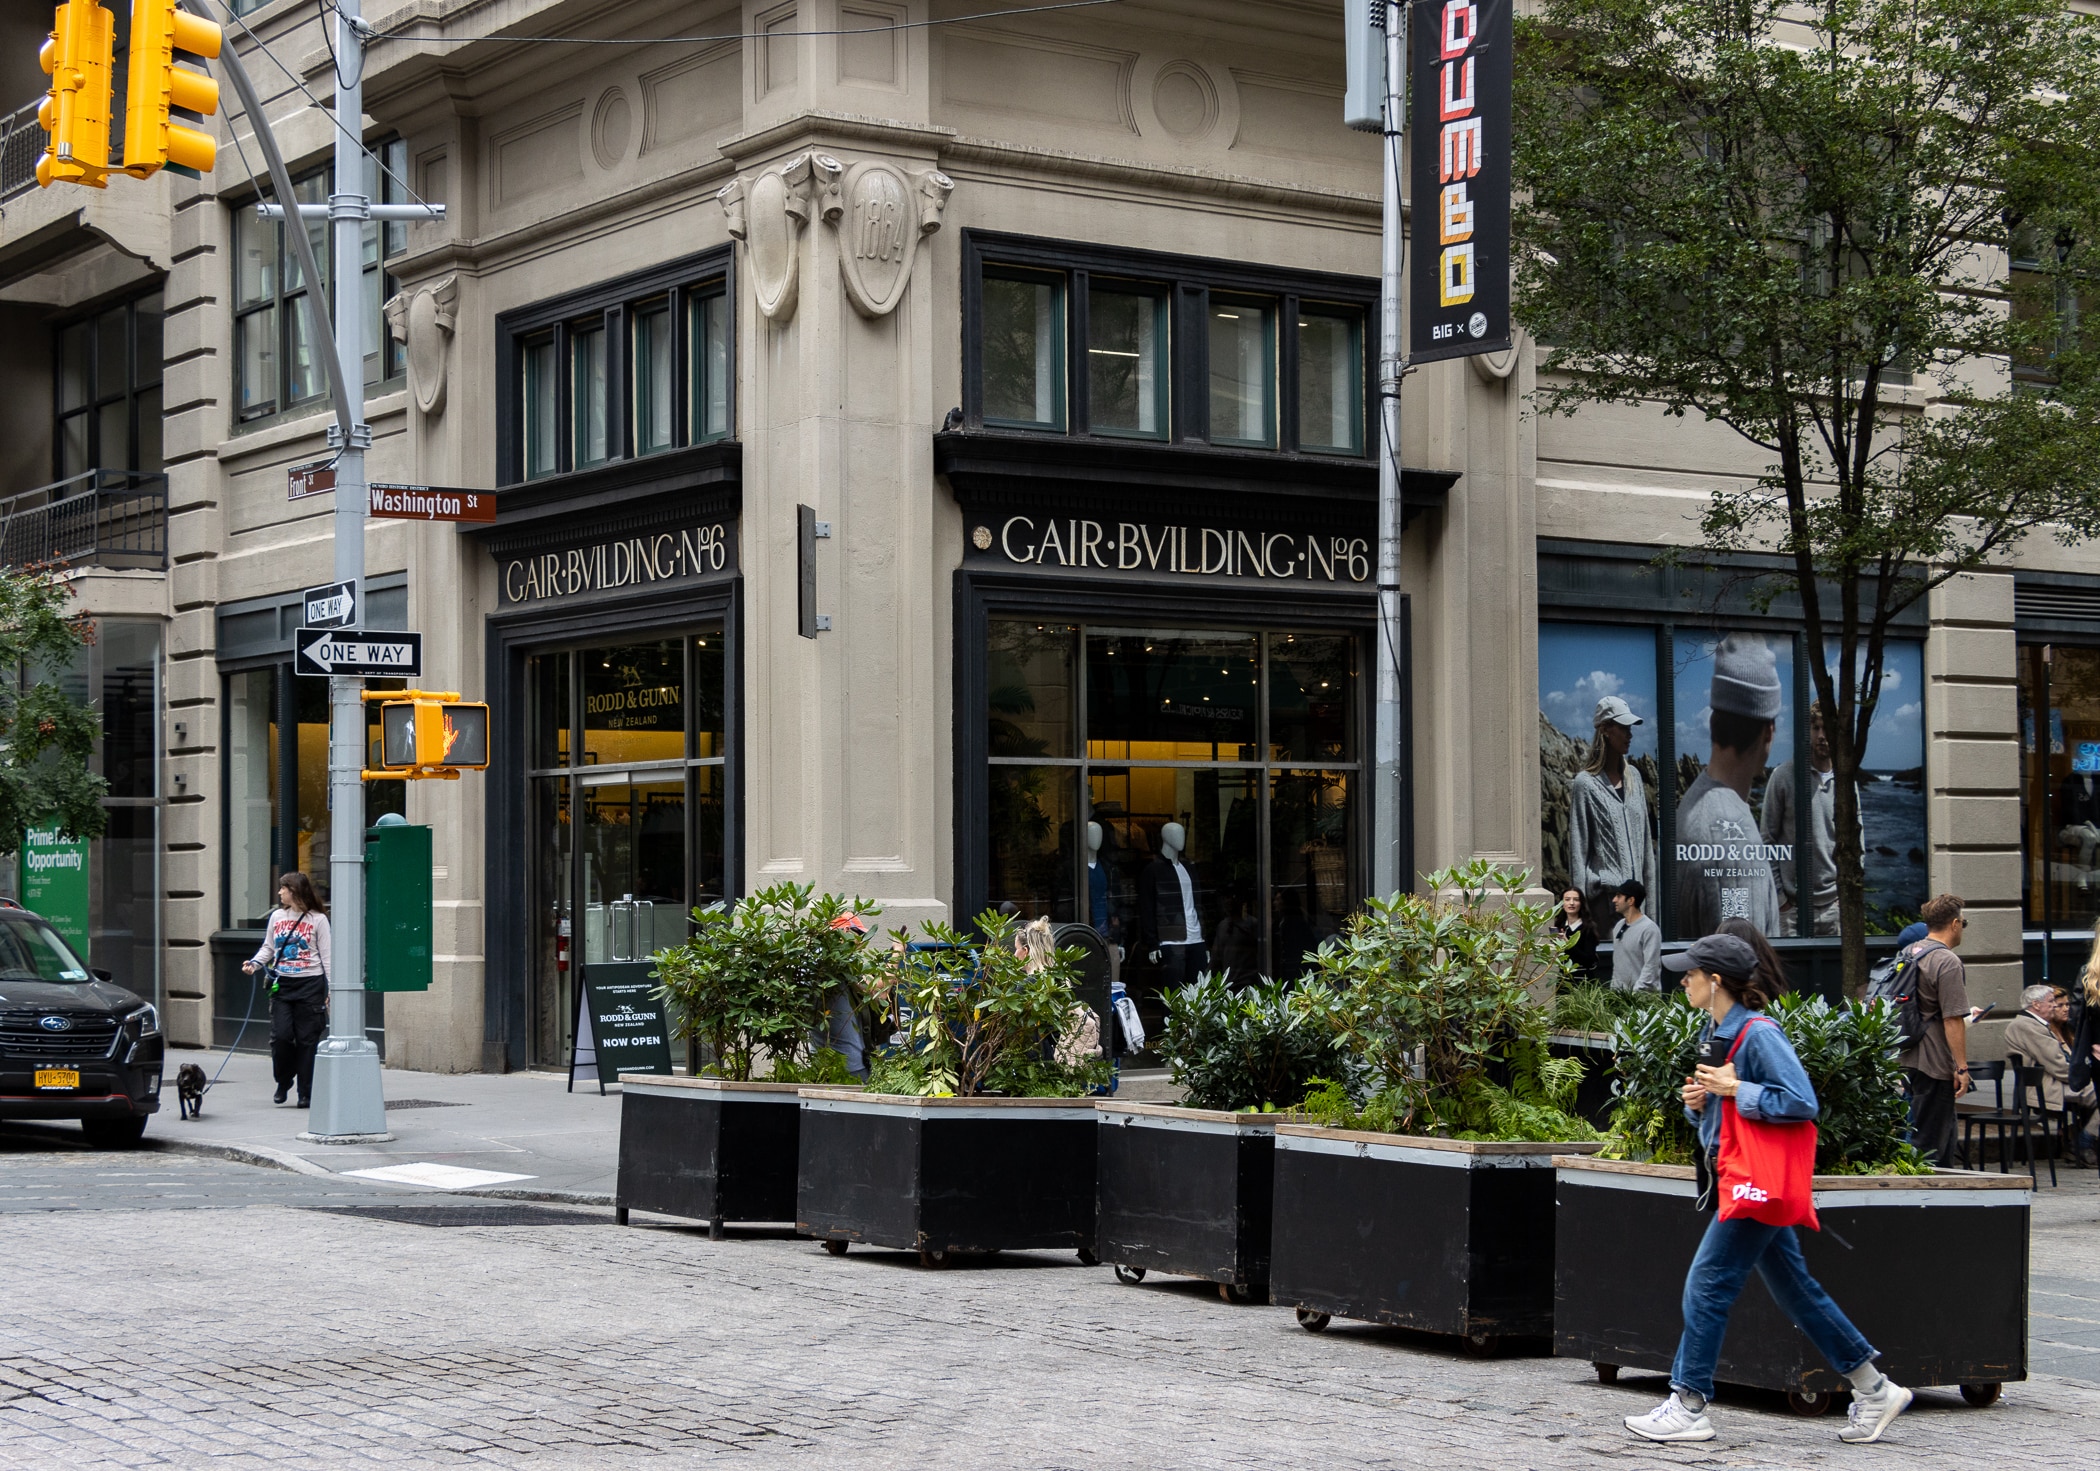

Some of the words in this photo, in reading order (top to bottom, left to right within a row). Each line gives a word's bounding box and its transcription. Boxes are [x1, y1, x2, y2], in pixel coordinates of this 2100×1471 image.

[1440, 0, 1482, 308] DUMBO
[855, 198, 905, 263] 1864
[1433, 323, 1453, 340] BIG
[289, 474, 307, 497] Front
[308, 474, 314, 486] St
[372, 490, 460, 519] Washington
[467, 495, 478, 509] St
[310, 601, 326, 620] ONE
[327, 597, 343, 617] WAY
[320, 644, 357, 661] ONE
[367, 645, 405, 663] WAY
[587, 692, 625, 714] RODD
[626, 690, 638, 709] &
[638, 686, 680, 708] GUNN
[608, 718, 624, 729] NEW
[625, 715, 658, 727] ZEALAND
[27, 828, 53, 847] Prime
[27, 849, 83, 872] Opportunity
[1676, 844, 1725, 861] RODD
[1727, 844, 1741, 861] &
[1742, 844, 1793, 861] GUNN
[1704, 868, 1724, 877] NEW
[1726, 868, 1766, 877] ZEALAND
[600, 1013, 624, 1023] RODD
[624, 1013, 632, 1022] &
[632, 1012, 656, 1021] GUNN
[603, 1038, 628, 1048] NOW
[631, 1036, 660, 1046] OPEN
[1732, 1181, 1768, 1202] Dia:
